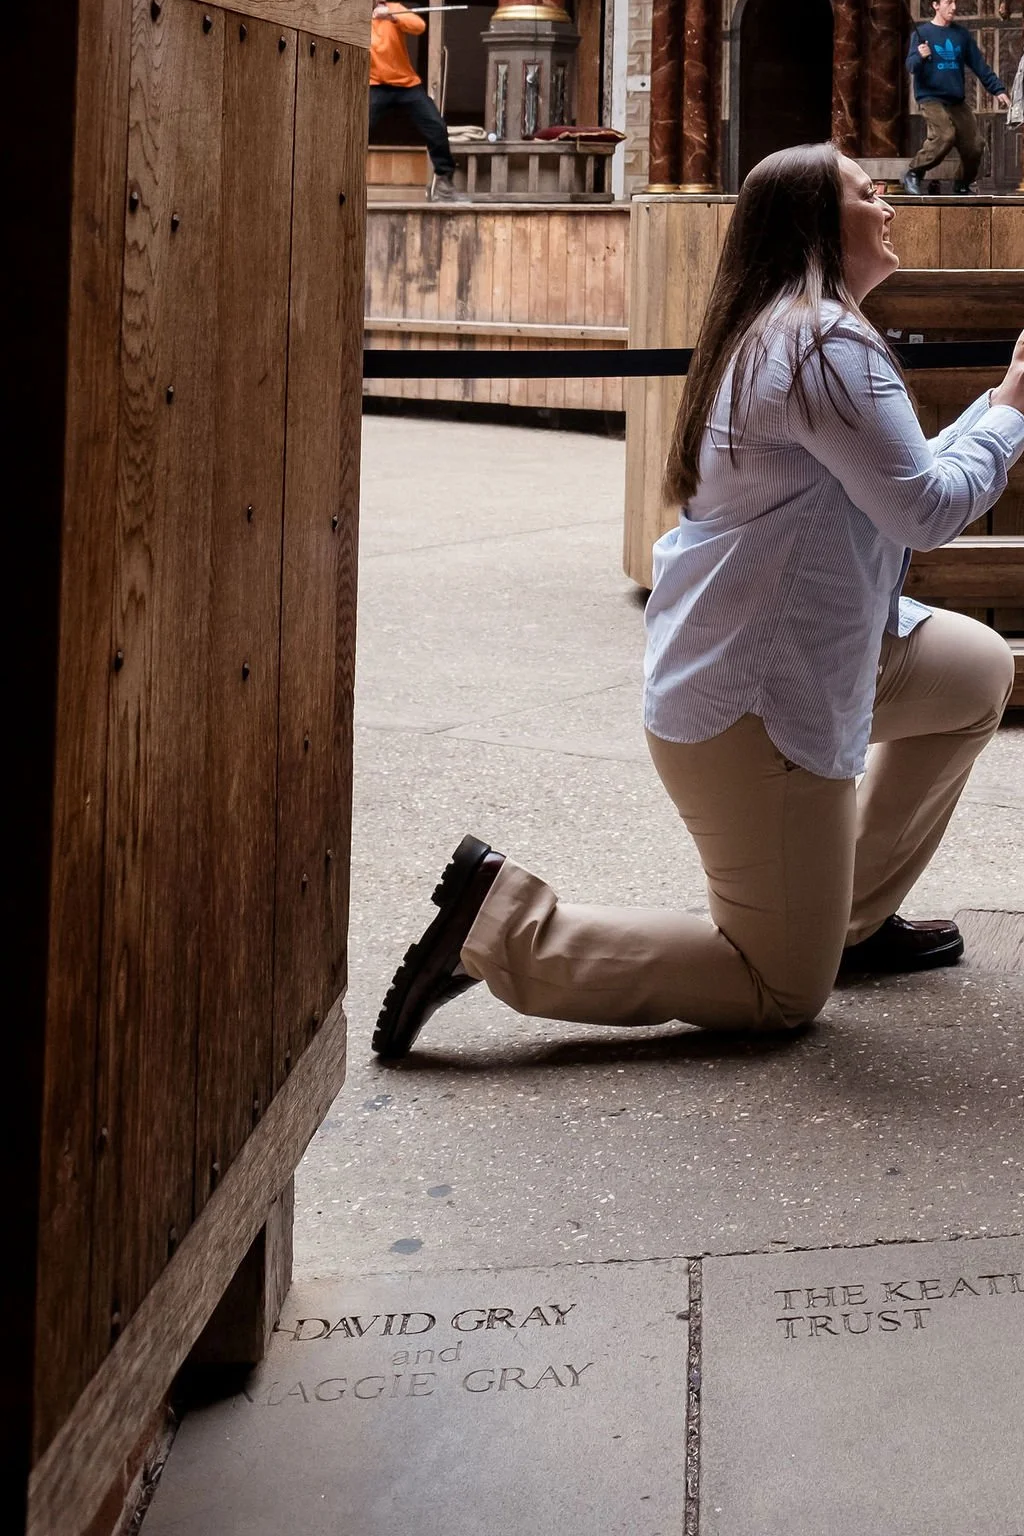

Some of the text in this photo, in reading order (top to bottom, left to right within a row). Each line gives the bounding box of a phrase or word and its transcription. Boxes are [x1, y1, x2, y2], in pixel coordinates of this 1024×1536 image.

[774, 1284, 868, 1310] THE
[290, 1303, 577, 1342] DAVID GRAY
[776, 1308, 931, 1339] TRUST
[392, 1340, 463, 1366] and
[462, 1362, 595, 1394] GRAY
